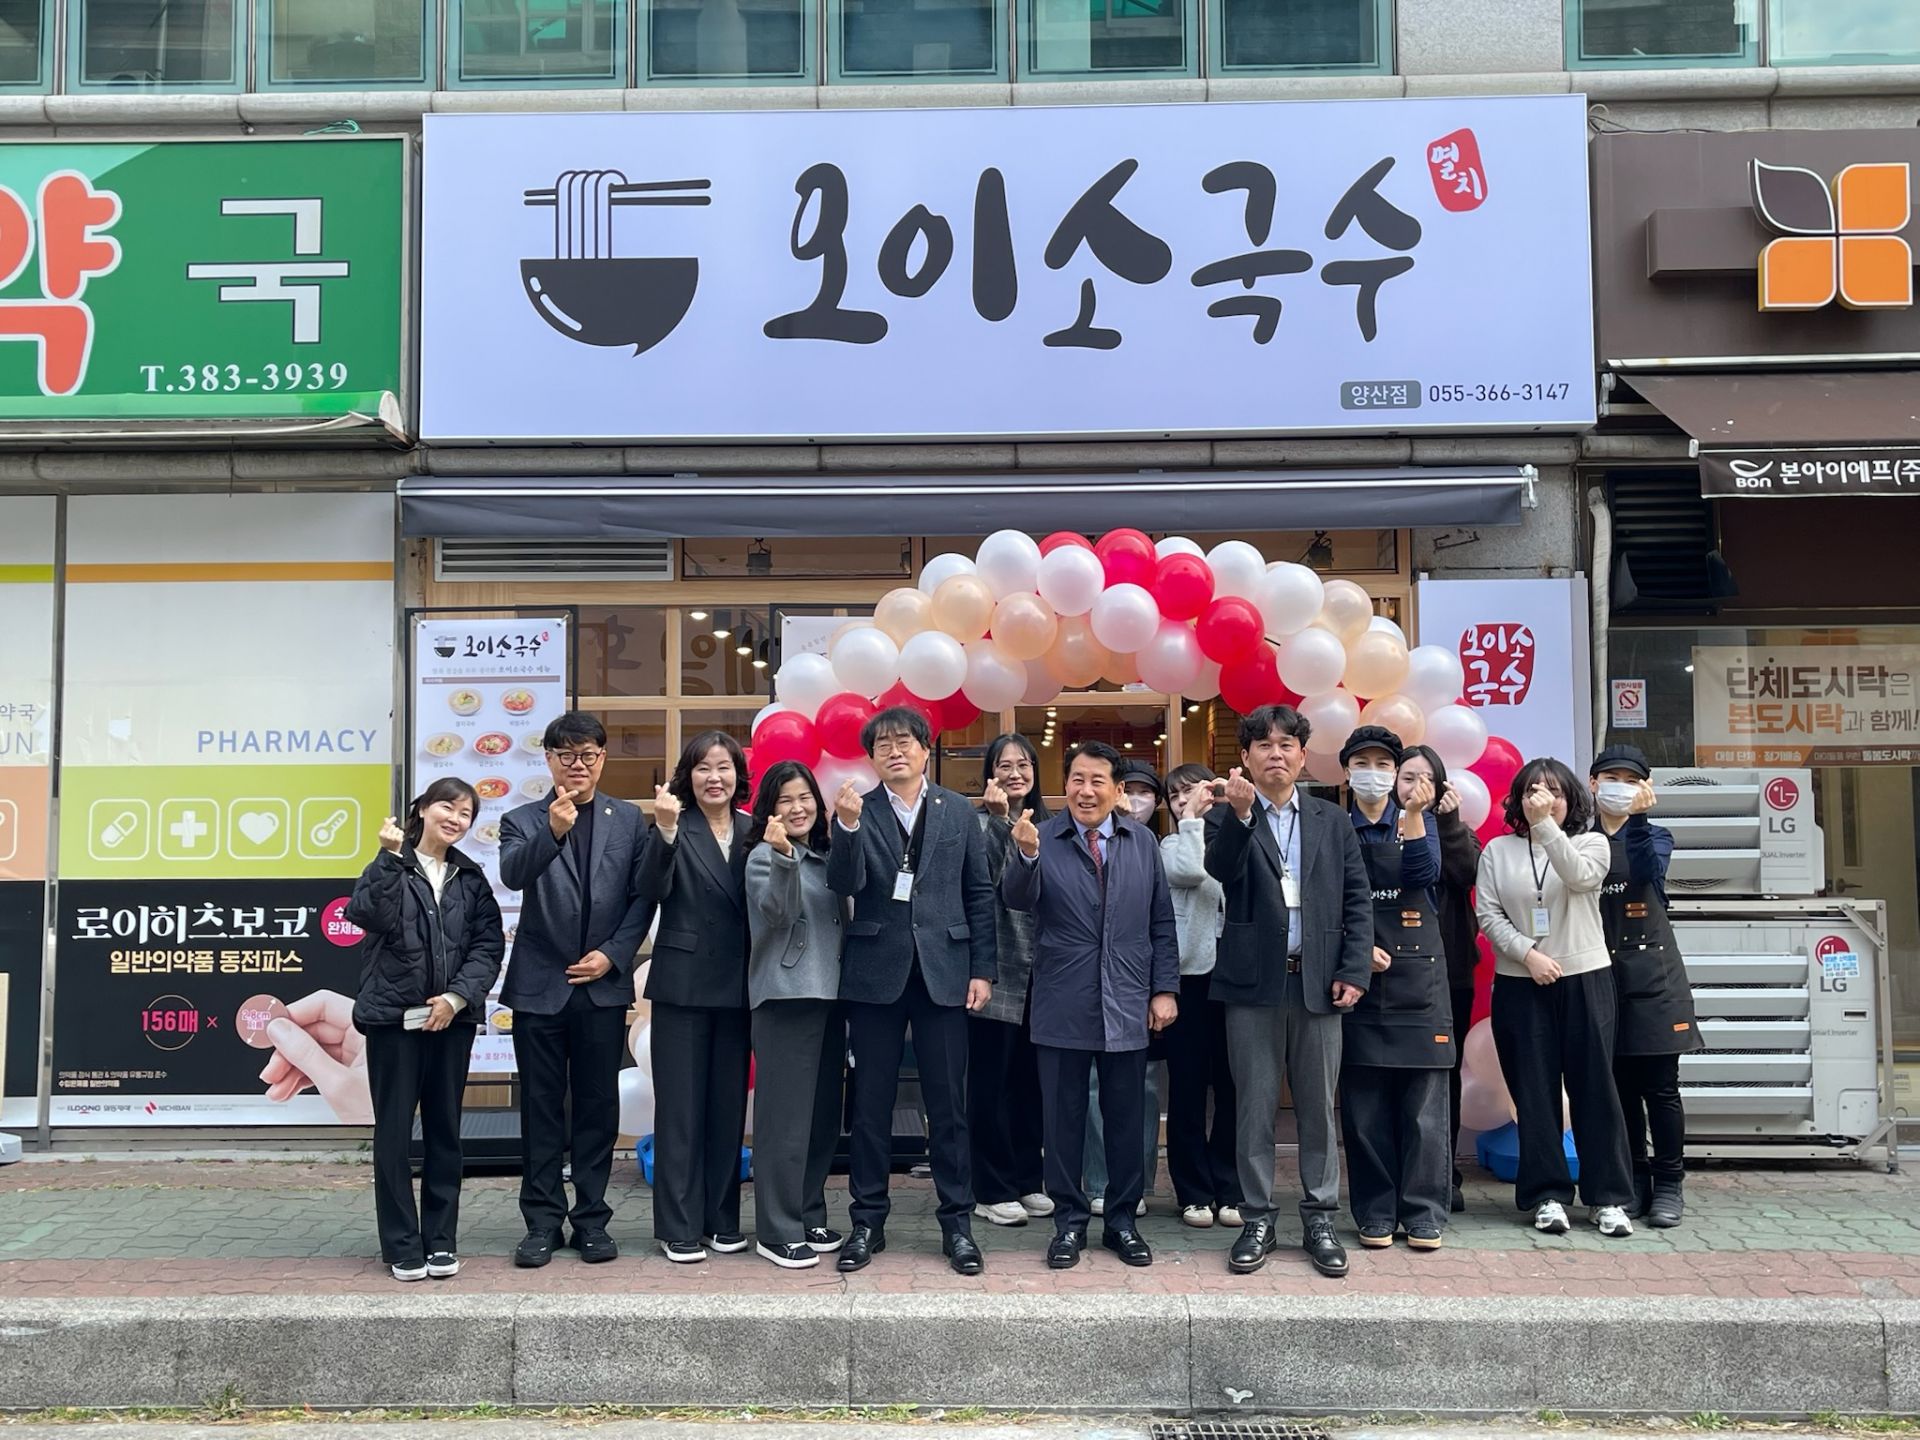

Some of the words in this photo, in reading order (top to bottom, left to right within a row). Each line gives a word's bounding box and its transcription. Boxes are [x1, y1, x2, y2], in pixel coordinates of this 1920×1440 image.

[763, 156, 1423, 349] 오이소국수
[0, 168, 349, 397] 약국
[140, 362, 348, 392] T.383-3939
[1350, 384, 1408, 406] 양산점
[1428, 383, 1570, 402] 055-366-3147
[462, 634, 542, 658] 오이소국수
[1462, 625, 1534, 658] 오이소
[1467, 659, 1526, 706] 국수
[1726, 665, 1911, 699] 단체도시락은
[1728, 703, 1865, 734] 본도시락과
[1870, 709, 1920, 732] 함께!
[198, 729, 378, 754] PHARMACY
[1768, 816, 1796, 834] LG
[72, 902, 310, 944] 로이히츠보코
[110, 950, 214, 973] 일반의약품
[219, 950, 303, 973] 동전파스
[1819, 976, 1848, 993] LG
[142, 1010, 198, 1033] 156매
